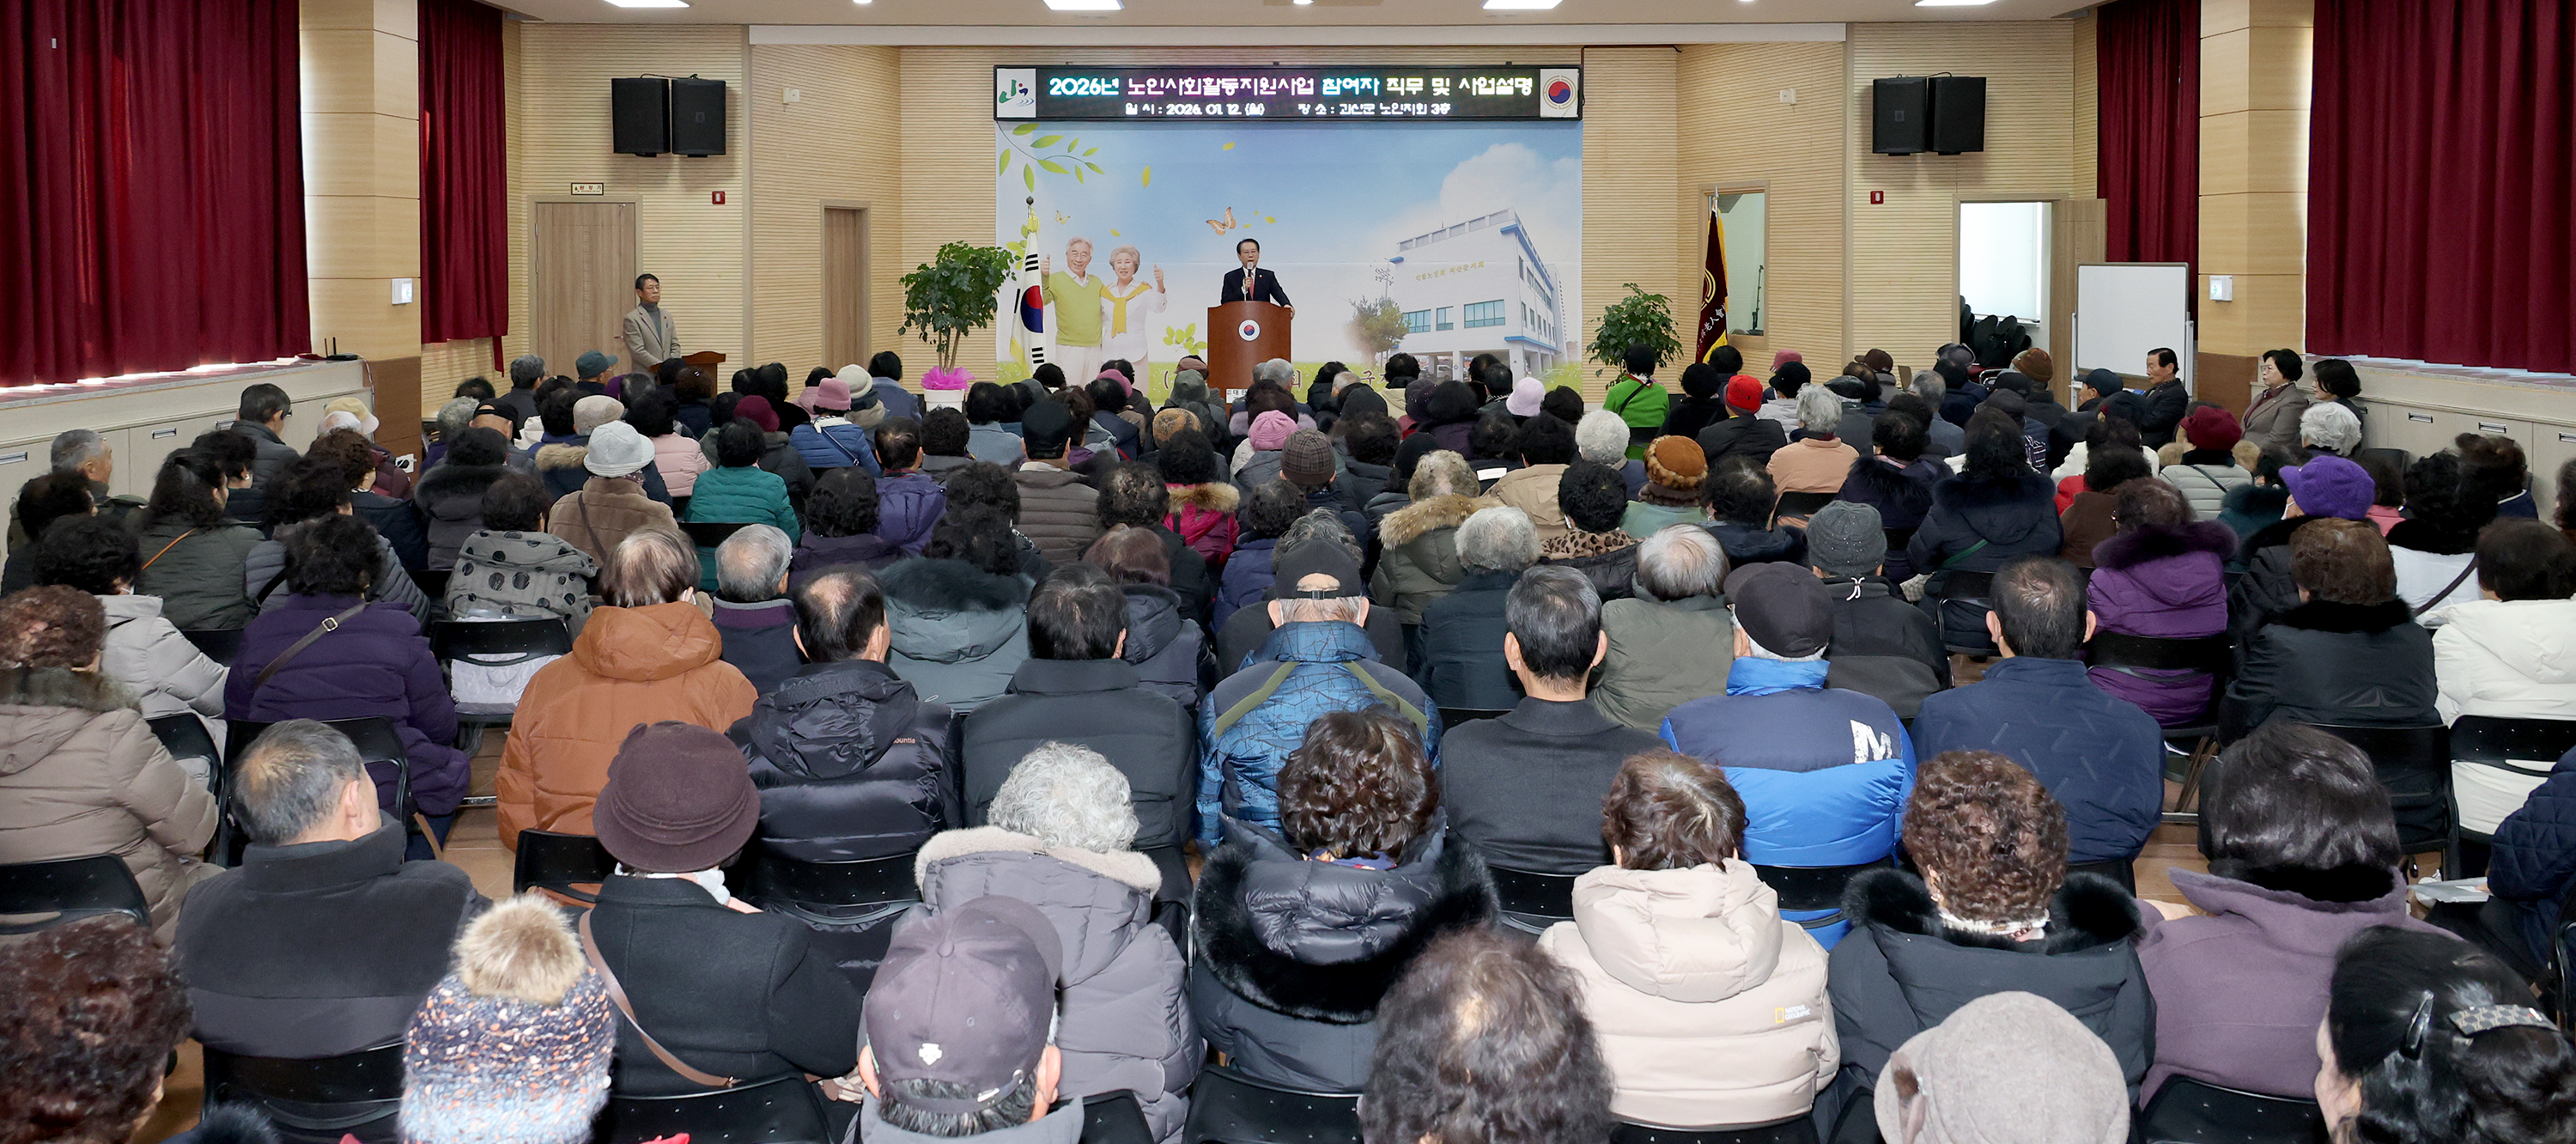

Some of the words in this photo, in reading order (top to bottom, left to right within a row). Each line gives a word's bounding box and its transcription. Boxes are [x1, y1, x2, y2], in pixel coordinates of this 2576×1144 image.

[1049, 77, 1120, 95] 2026년
[1127, 76, 1315, 96] 노인사회활동지원사업
[1322, 77, 1381, 96] 참여자
[1386, 77, 1424, 96] 직무
[1431, 77, 1450, 96] 및
[1458, 76, 1533, 96] 사업설명
[1339, 103, 1376, 115] 괴산군
[1379, 102, 1428, 116] 노인지회
[1431, 102, 1451, 115] 3층
